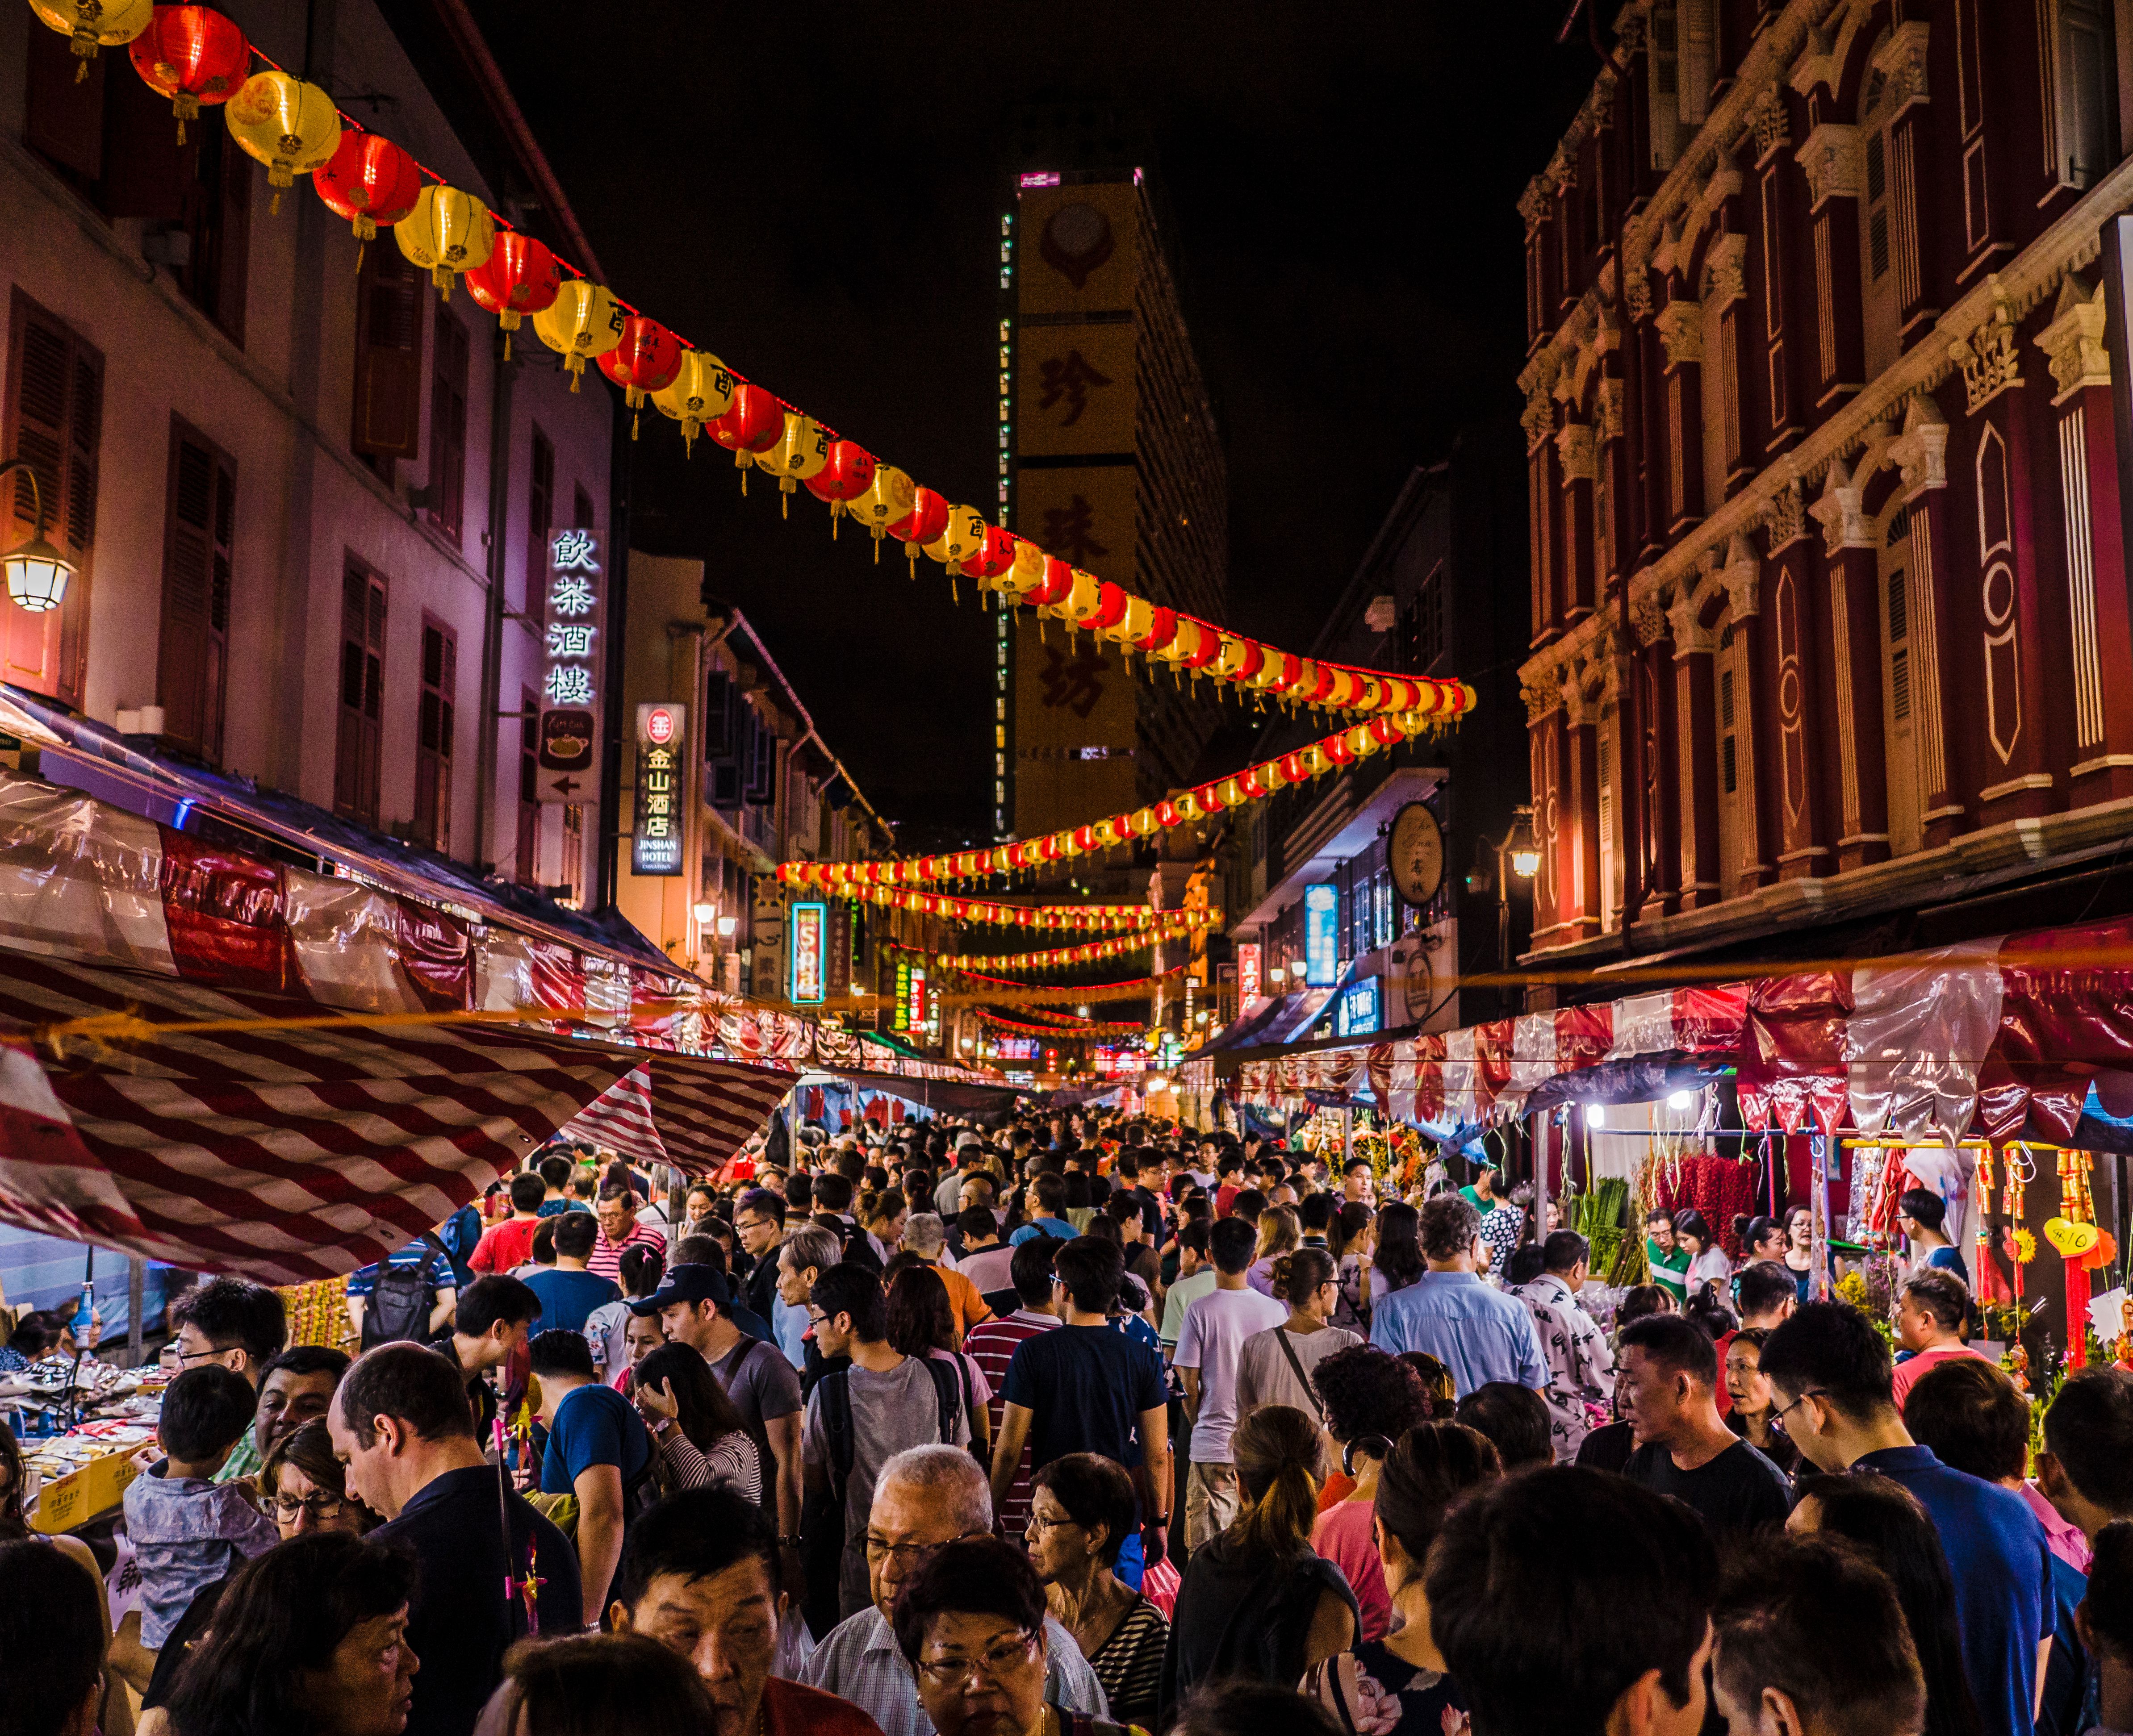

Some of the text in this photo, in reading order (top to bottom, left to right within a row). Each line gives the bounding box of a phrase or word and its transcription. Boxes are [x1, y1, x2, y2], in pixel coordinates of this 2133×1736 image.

[546, 530, 598, 704] 飲茶酒樓
[647, 748, 671, 837] 金山酒店
[639, 839, 677, 850] JINSHAN
[642, 851, 672, 862] HOTEL
[800, 925, 817, 987] Spa
[2053, 1229, 2087, 1247] $10
